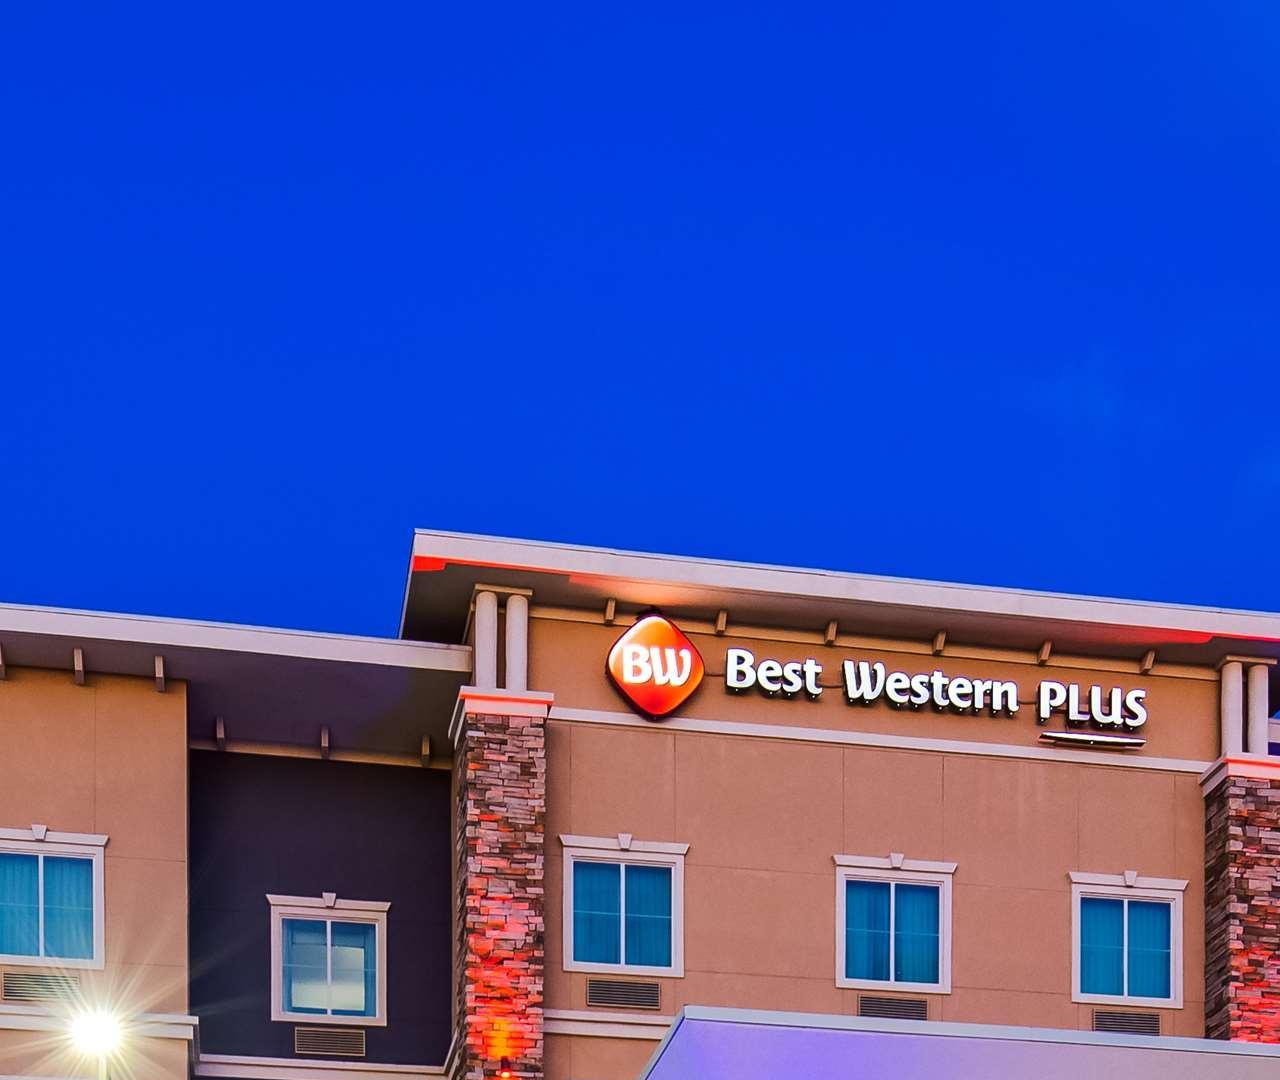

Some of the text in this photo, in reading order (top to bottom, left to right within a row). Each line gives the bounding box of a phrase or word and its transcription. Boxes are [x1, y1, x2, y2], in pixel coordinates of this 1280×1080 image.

[622, 643, 692, 687] BW
[726, 647, 1148, 728] Best Western PLUS
